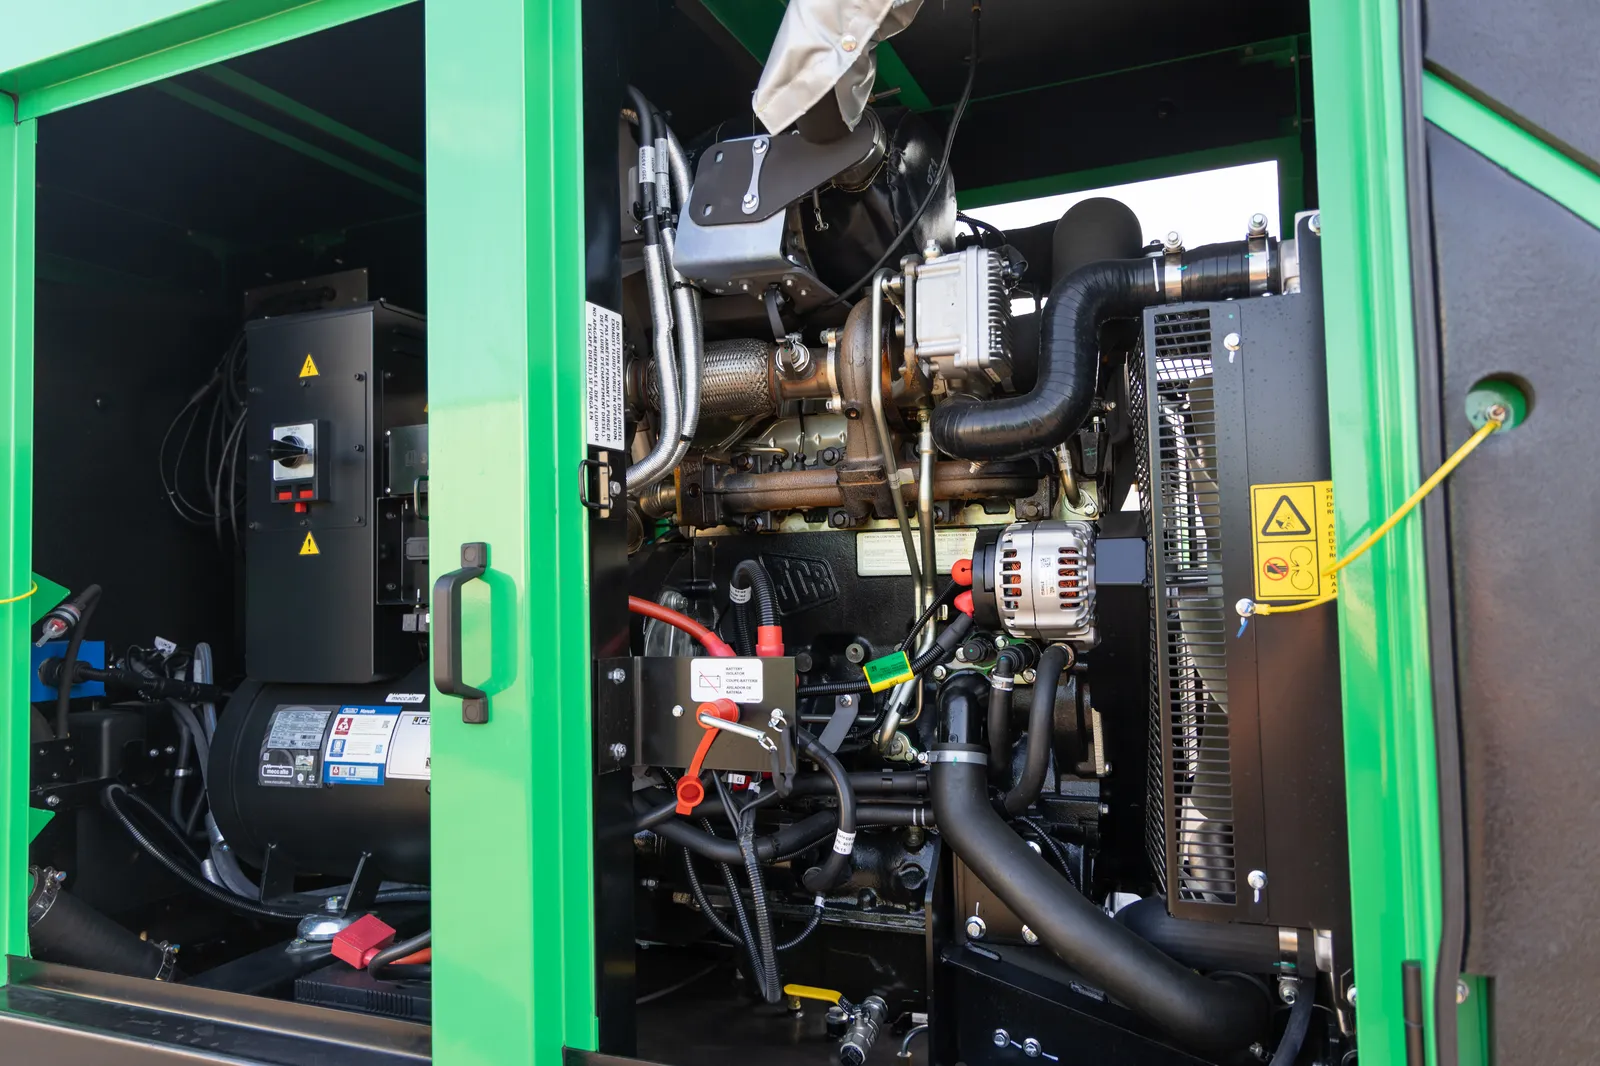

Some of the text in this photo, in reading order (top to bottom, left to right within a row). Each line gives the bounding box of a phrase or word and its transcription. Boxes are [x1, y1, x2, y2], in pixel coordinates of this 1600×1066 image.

[605, 314, 608, 322] NE
[616, 320, 620, 330] DO
[592, 307, 596, 317] NO
[595, 433, 599, 443] DE
[606, 400, 610, 408] LA
[589, 411, 593, 420] EN
[607, 433, 611, 442] DE
[778, 558, 833, 604] JCB
